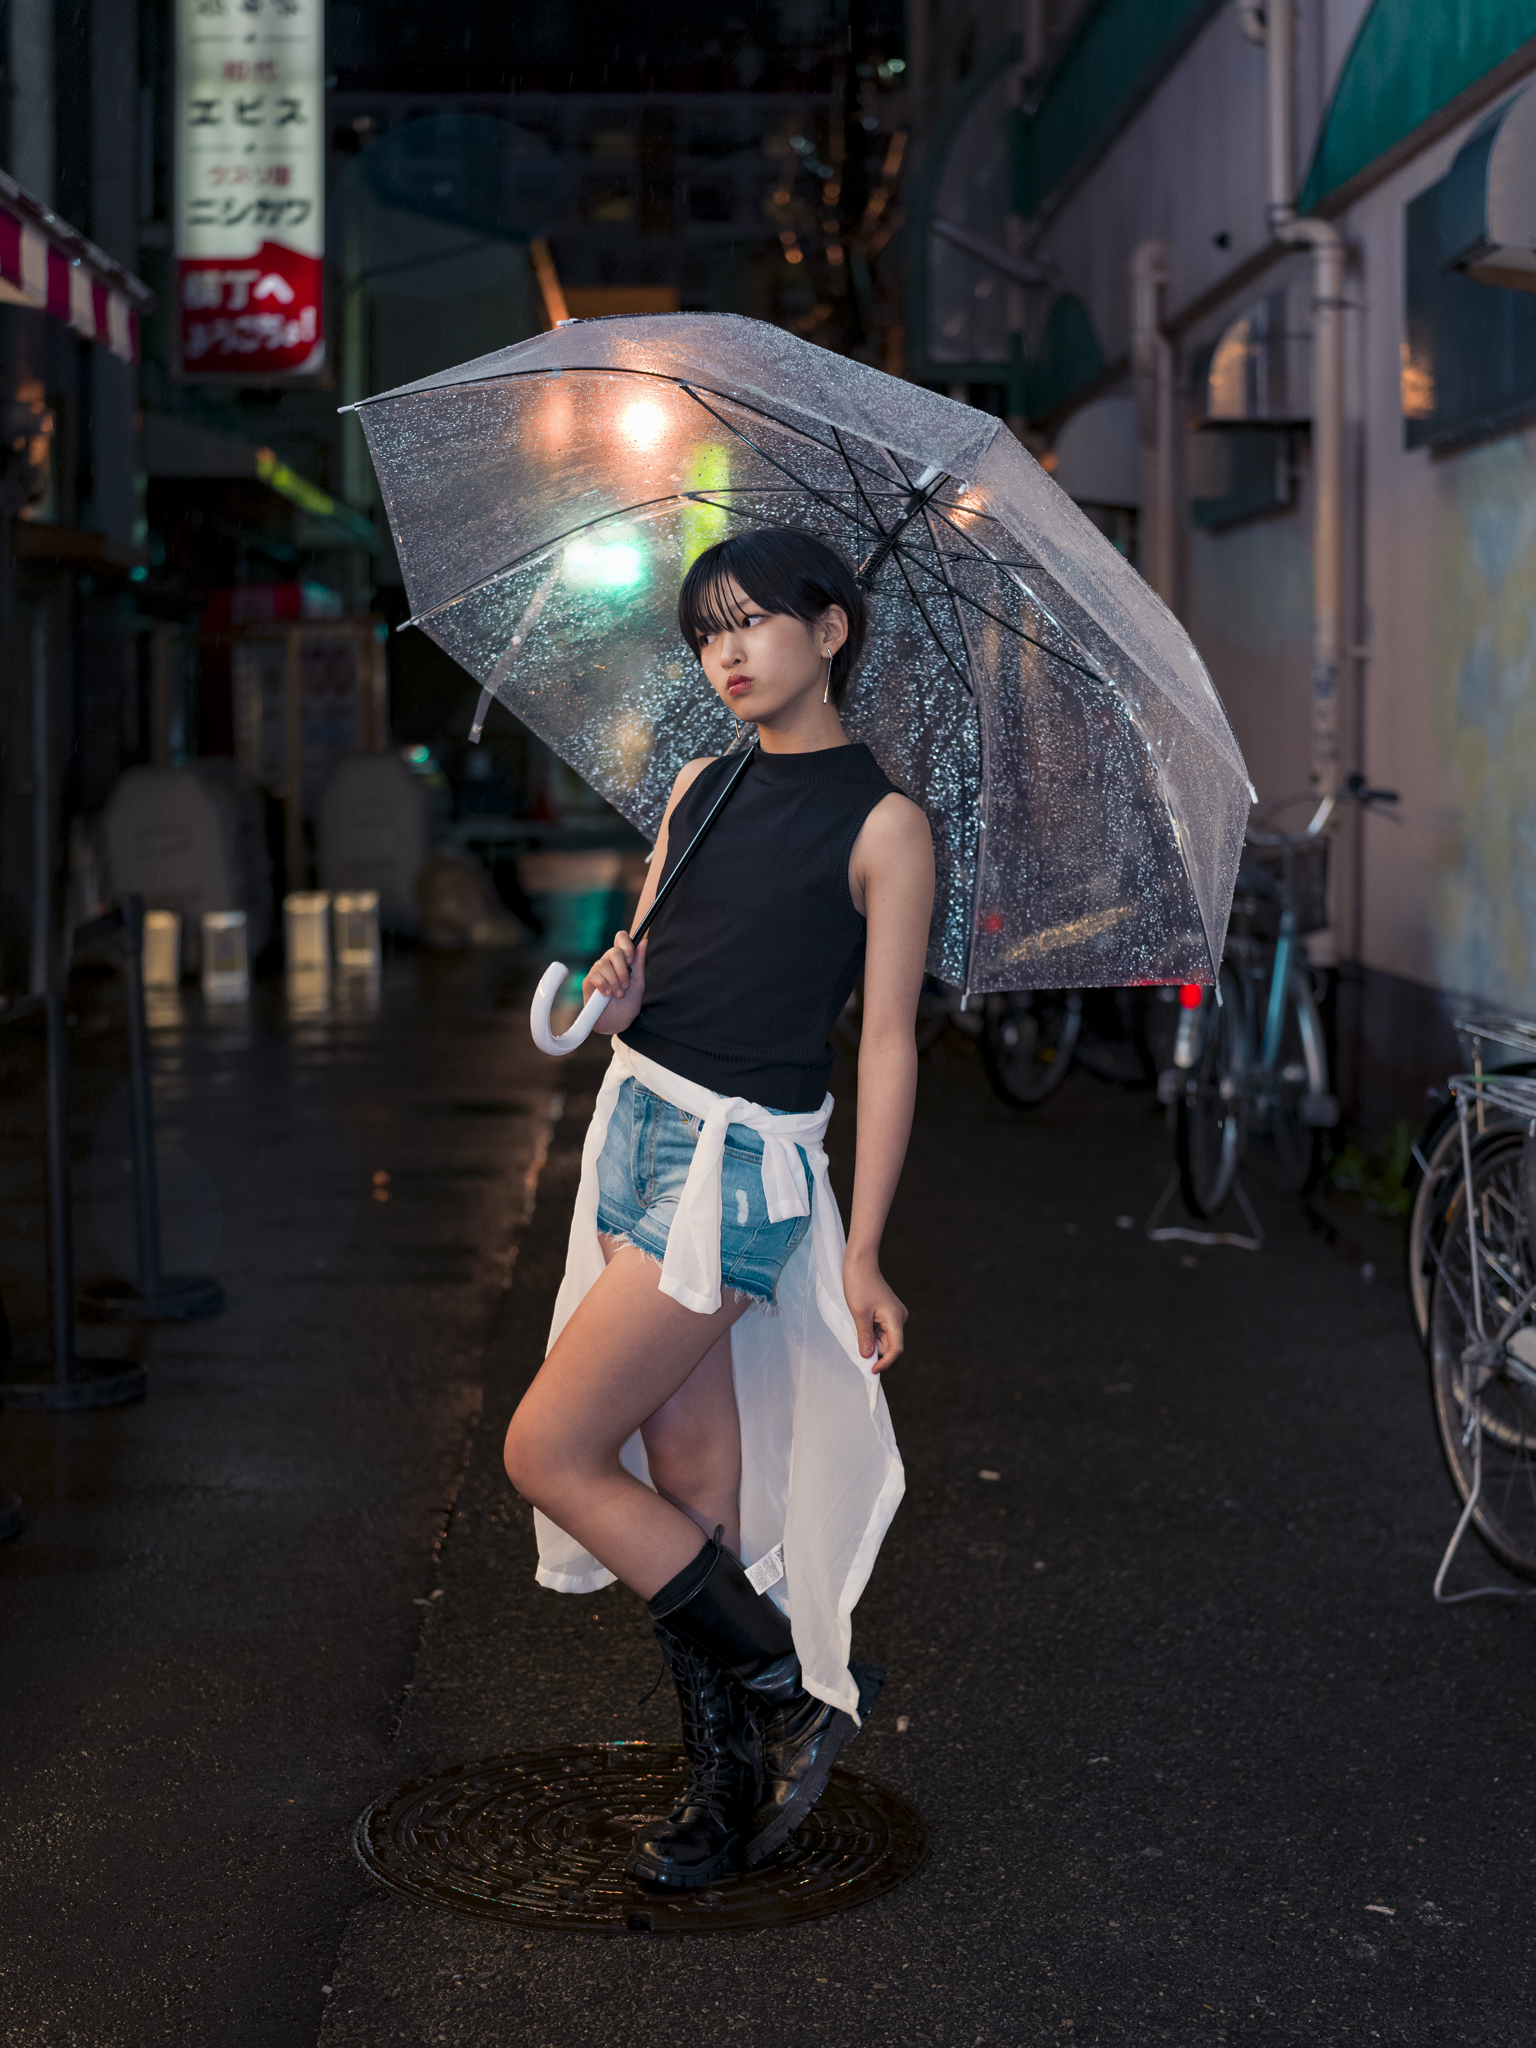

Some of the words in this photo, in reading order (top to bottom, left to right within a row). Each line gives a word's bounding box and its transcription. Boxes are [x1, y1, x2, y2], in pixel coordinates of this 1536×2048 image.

[188, 97, 307, 127] エビス
[186, 196, 312, 226] ニシカワ
